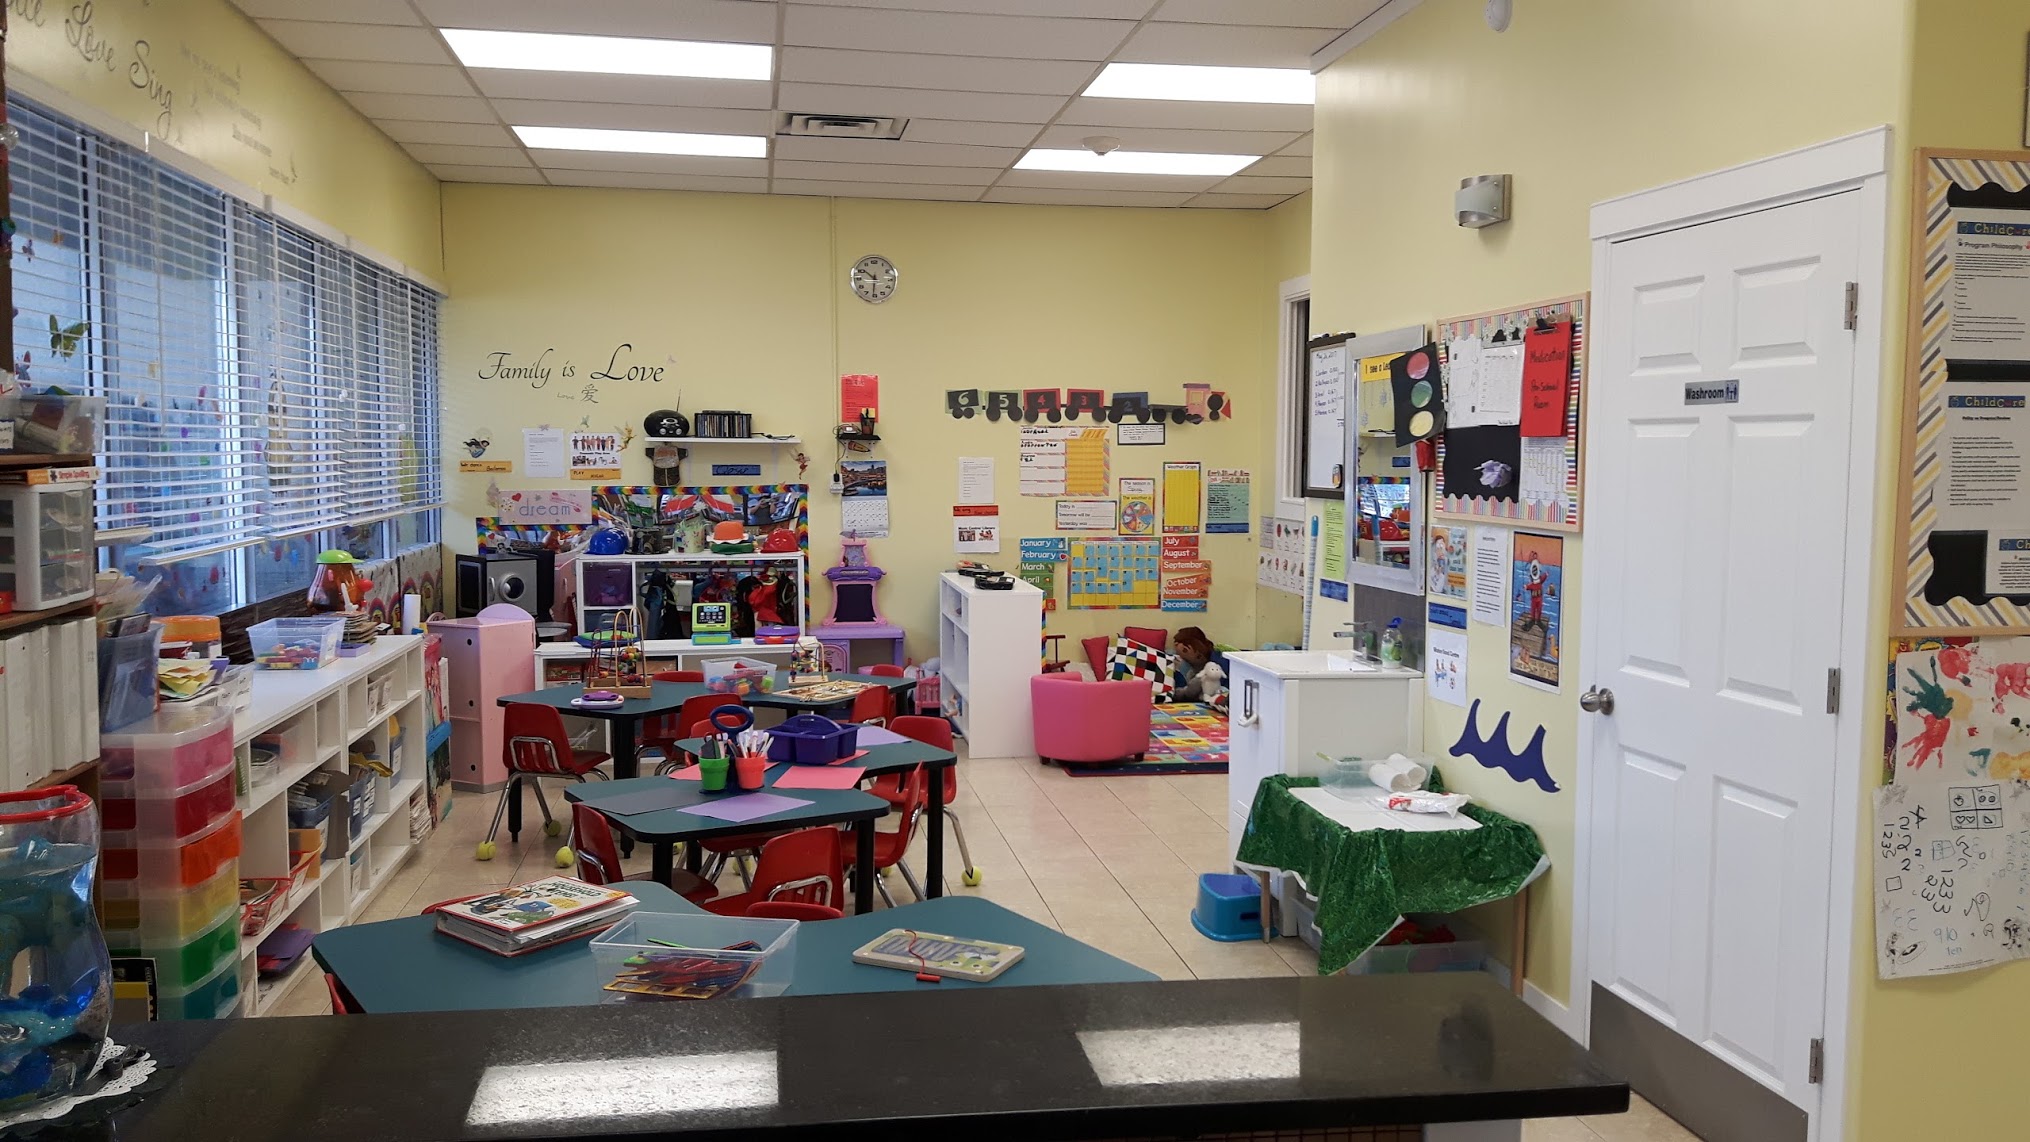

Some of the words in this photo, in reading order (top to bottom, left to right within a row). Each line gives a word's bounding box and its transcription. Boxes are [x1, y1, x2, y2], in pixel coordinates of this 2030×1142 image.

[65, 1, 117, 72] Love
[129, 40, 173, 141] Sing
[478, 348, 554, 389] Family
[562, 360, 576, 378] is
[590, 343, 664, 382] Love
[581, 383, 599, 404] 爱
[958, 391, 970, 405] 6
[1685, 387, 1725, 400] Washroom
[999, 394, 1010, 408] 5
[1037, 395, 1046, 405] 4
[1081, 395, 1087, 406] 3
[1123, 401, 1133, 411] 2
[519, 498, 571, 516] dream
[1020, 539, 1051, 548] January
[1164, 537, 1180, 546] July
[1021, 551, 1056, 560] February
[1164, 549, 1190, 558] August
[1164, 561, 1203, 570] September
[1023, 575, 1040, 584] April
[1167, 576, 1197, 588] October
[1163, 587, 1198, 595] November
